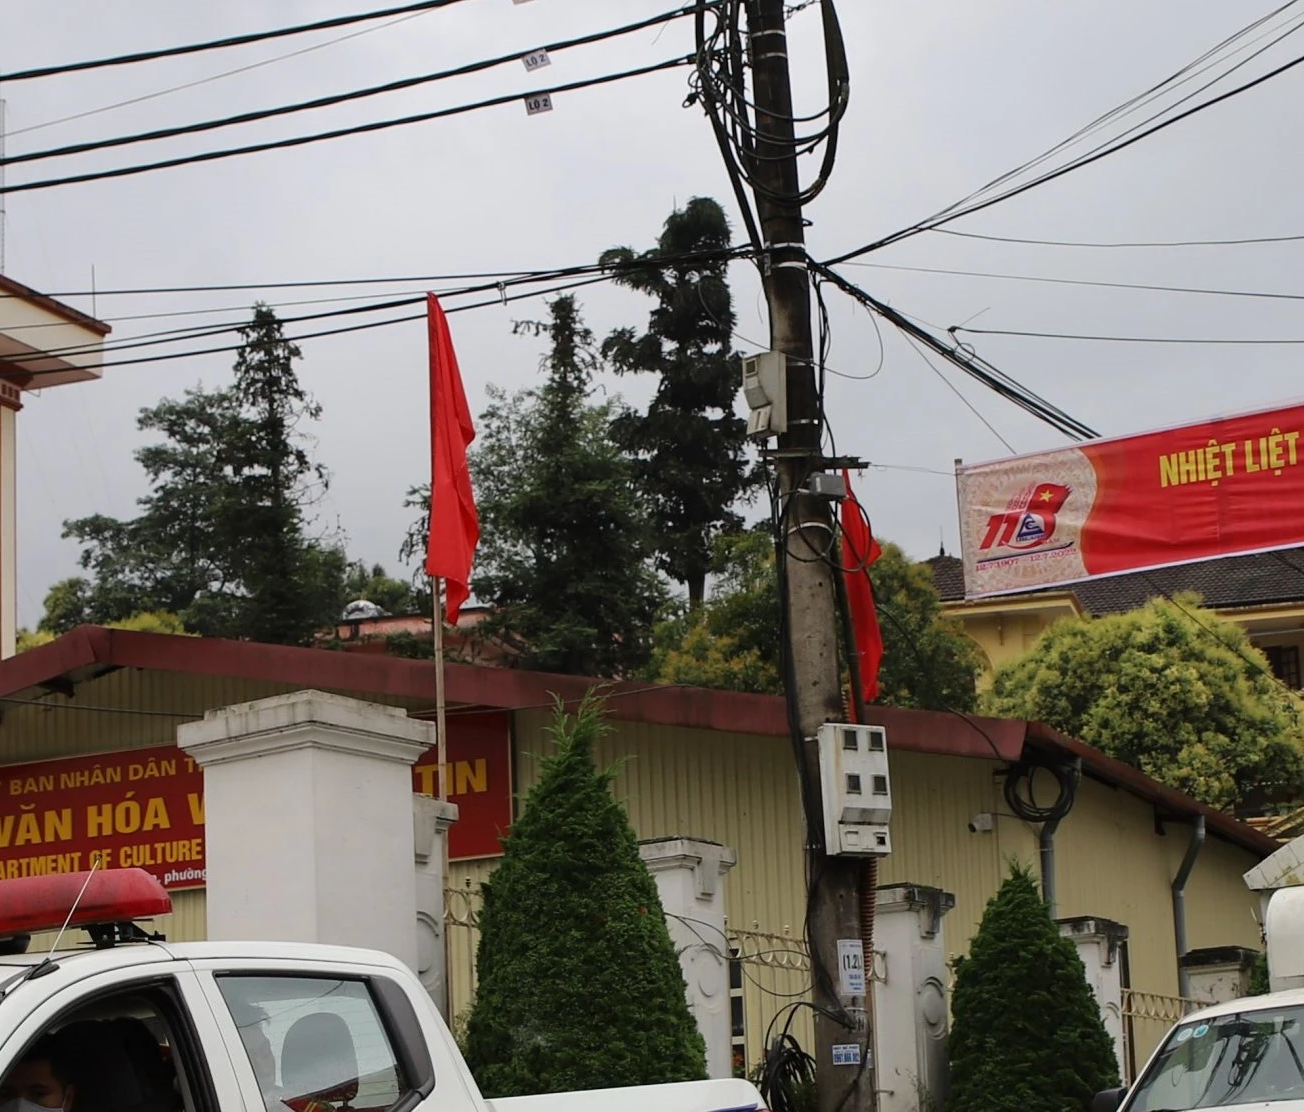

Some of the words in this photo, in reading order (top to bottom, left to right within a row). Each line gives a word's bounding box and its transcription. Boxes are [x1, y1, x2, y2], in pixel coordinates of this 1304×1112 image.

[1159, 440, 1236, 487] NHIỆT
[1245, 428, 1299, 476] LIỆT
[9, 775, 54, 796] BAN
[60, 764, 121, 790] NHÂN
[128, 758, 177, 782] DÂN
[86, 791, 171, 837] HÓA
[90, 849, 112, 872] OF
[119, 839, 202, 869] CULTURE
